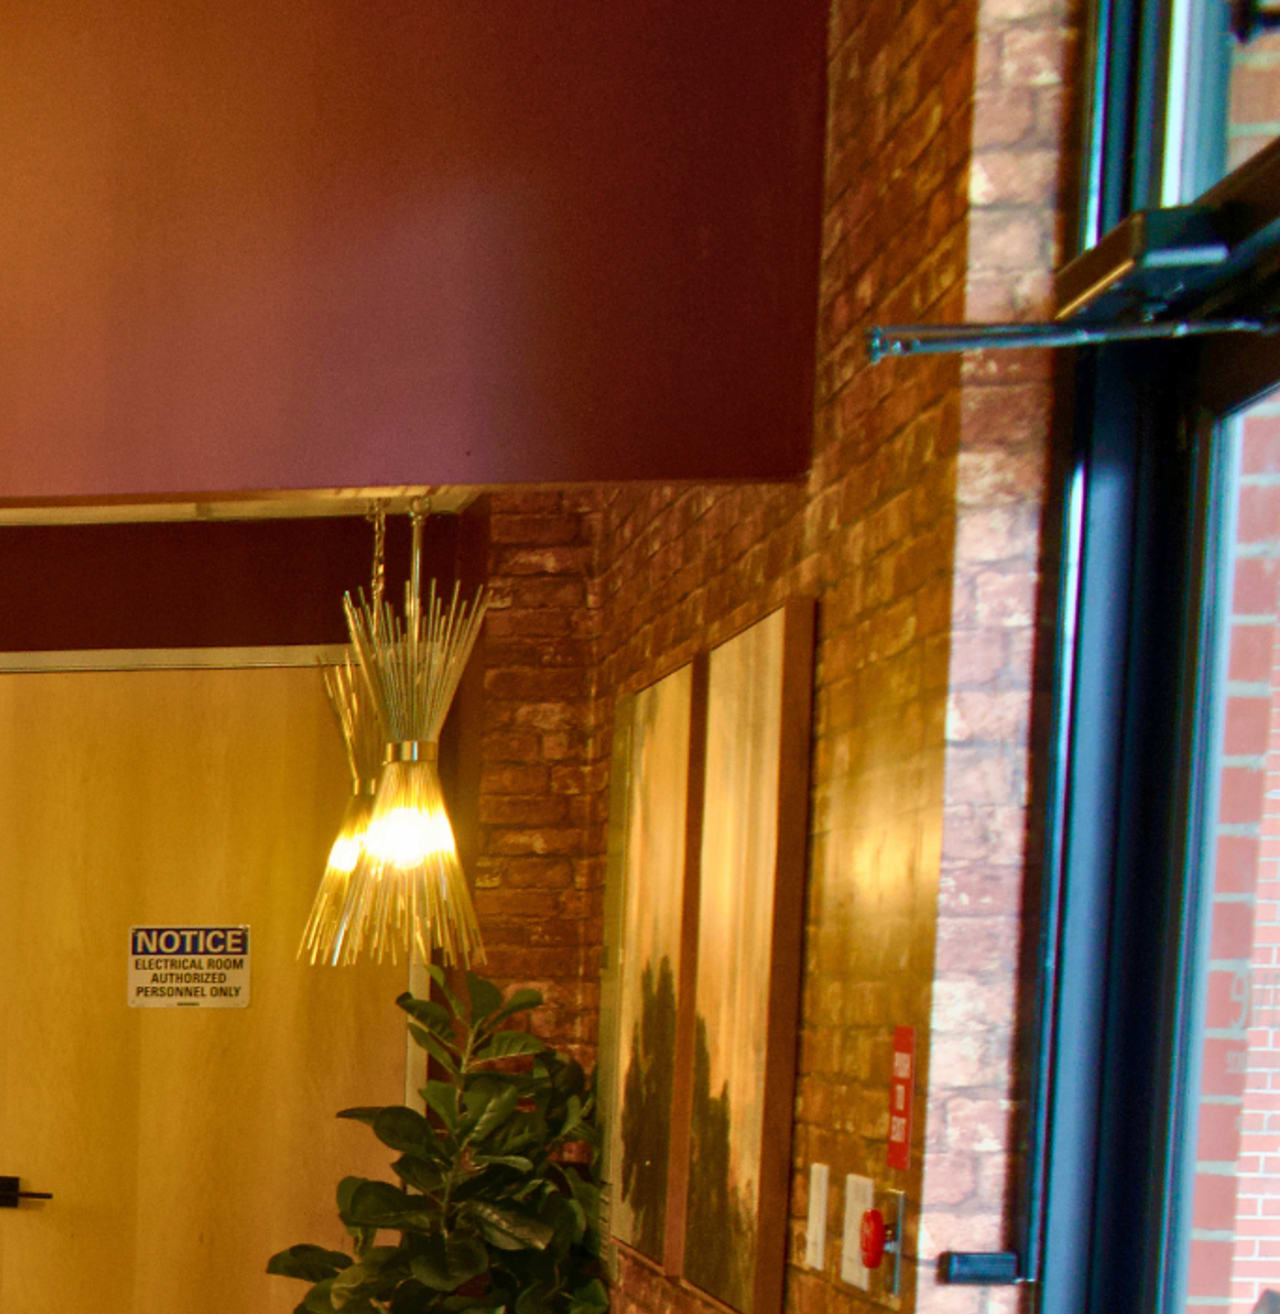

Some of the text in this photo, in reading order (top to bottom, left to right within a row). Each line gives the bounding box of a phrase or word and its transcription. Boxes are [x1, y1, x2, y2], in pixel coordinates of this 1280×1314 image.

[136, 930, 243, 953] NOTICE
[134, 958, 244, 971] ELECTRICAL ROOM
[150, 972, 227, 984] AUTHORIZED
[135, 986, 242, 997] PERSONNEL ONLY
